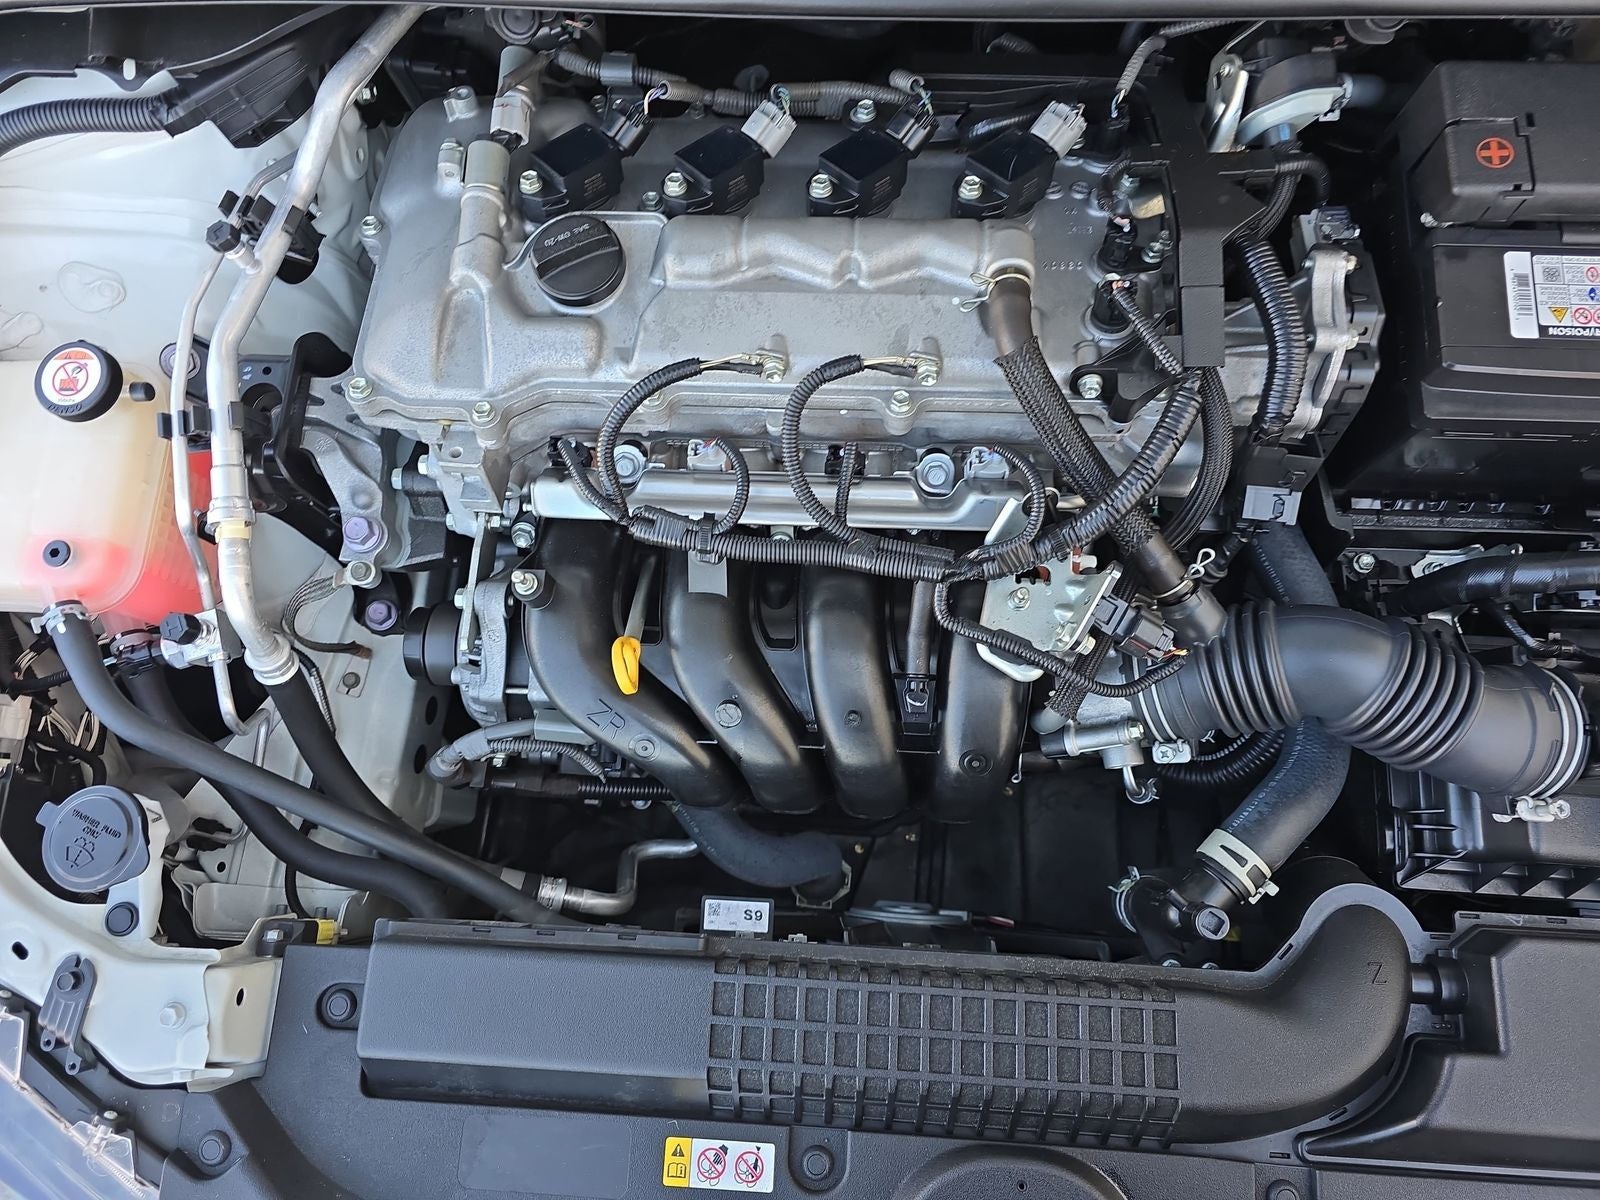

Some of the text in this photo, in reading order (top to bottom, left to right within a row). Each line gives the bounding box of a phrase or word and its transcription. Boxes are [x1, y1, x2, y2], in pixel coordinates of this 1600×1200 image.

[586, 698, 626, 741] ZR
[72, 808, 122, 839] WASHER FLUID
[82, 826, 101, 839] ONLY
[744, 909, 763, 921] S9
[1368, 961, 1388, 985] Z
